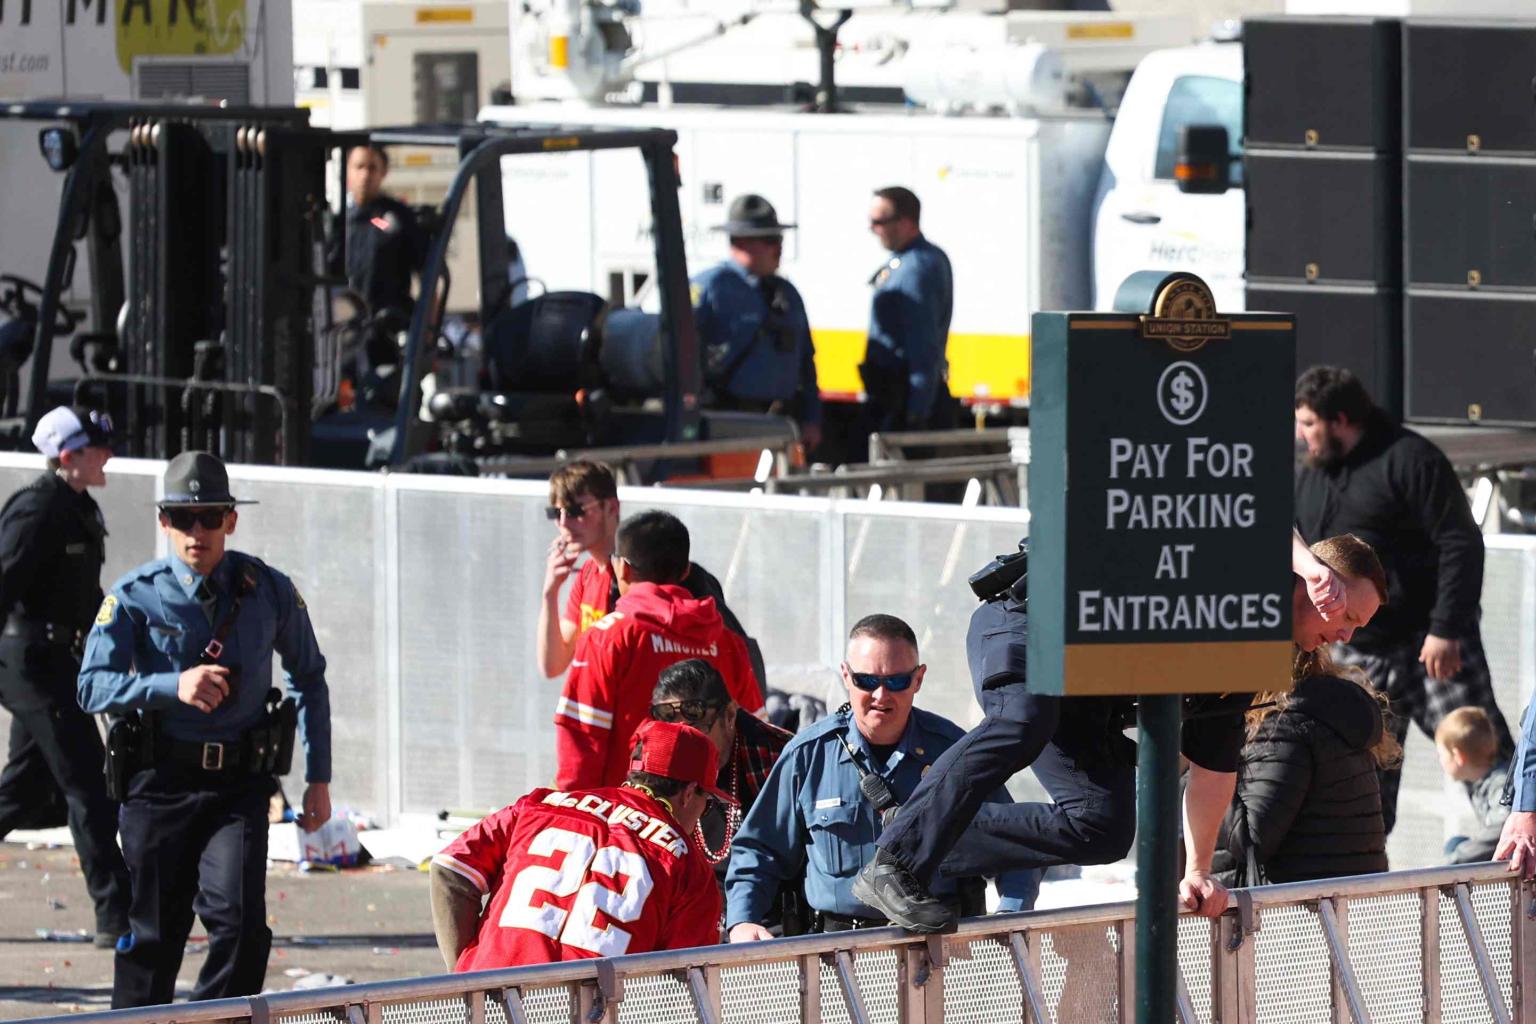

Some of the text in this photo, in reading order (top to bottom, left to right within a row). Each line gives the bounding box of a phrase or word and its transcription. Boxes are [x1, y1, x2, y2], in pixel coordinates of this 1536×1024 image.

[1149, 321, 1226, 335] UNION STATION
[1109, 436, 1253, 479] PAY FOR
[1106, 488, 1256, 529] PARKING
[1154, 543, 1195, 579] AT
[1077, 590, 1281, 632] ENTRANCES
[540, 791, 689, 860] McCLUSTER
[498, 826, 654, 958] 22
